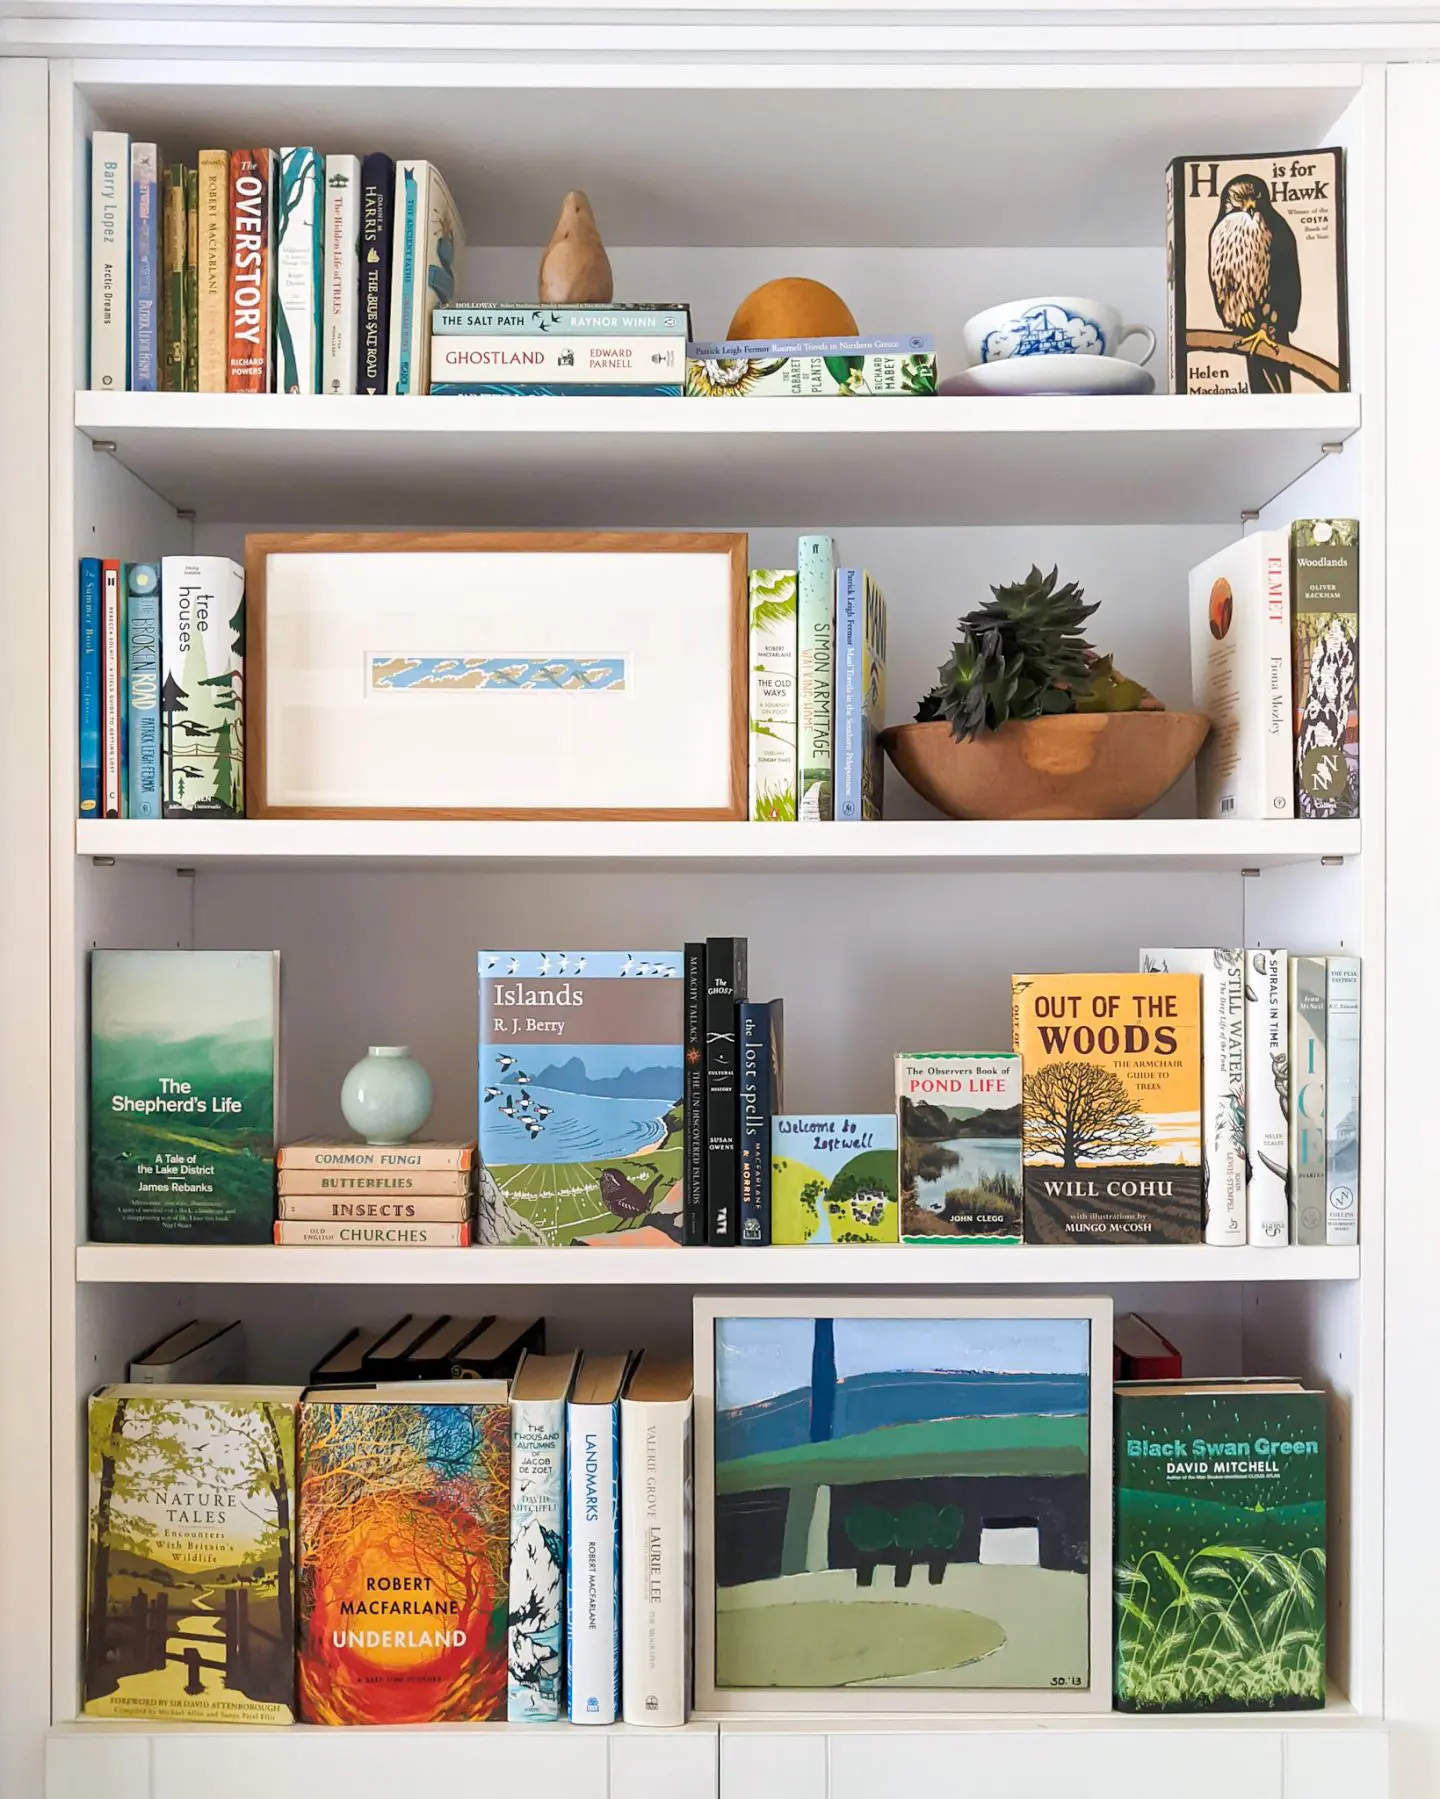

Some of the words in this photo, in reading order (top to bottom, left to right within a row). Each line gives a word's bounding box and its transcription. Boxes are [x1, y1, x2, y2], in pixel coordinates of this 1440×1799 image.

[240, 161, 258, 171] The
[1272, 162, 1286, 178] is
[1289, 160, 1316, 178] for
[102, 162, 117, 198] Barry
[1189, 163, 1219, 197] H
[208, 176, 217, 216] ROBERT
[334, 197, 342, 213] The
[364, 186, 377, 241] HARRIS
[102, 205, 117, 243] Lopez
[334, 217, 343, 249] Hidden
[208, 223, 217, 295] MACFARLANE
[234, 176, 262, 344] OVERSTORY
[333, 252, 342, 268] Life
[104, 264, 113, 289] Arctic
[333, 271, 342, 280] of
[368, 269, 378, 292] THE
[103, 293, 113, 324] Dreams
[333, 283, 341, 315] TREES
[367, 293, 378, 320] BLUE
[442, 316, 462, 325] THE
[467, 316, 493, 326] SALT
[497, 317, 524, 326] PATH
[570, 317, 617, 326] RAYNOR
[623, 317, 656, 326] WINN
[365, 322, 377, 346] SALT
[230, 358, 264, 366] RICHARD
[366, 348, 377, 378] ROAD
[445, 351, 545, 365] GHOSTLAND
[590, 349, 632, 358] EDWARD
[231, 367, 262, 375] POWERS
[589, 359, 632, 368] PARNELL
[1189, 365, 1229, 379] Helen
[791, 359, 801, 393] CABARET
[810, 358, 822, 392] PLANTS
[874, 357, 883, 390] RICHARD
[884, 357, 895, 390] MABEY
[1189, 382, 1249, 395] Macdonald
[1297, 557, 1348, 567] Woodlands
[1268, 557, 1283, 624] ELMET
[179, 586, 201, 652] houses
[197, 594, 214, 632] tree
[813, 623, 831, 673] SIMON
[1270, 657, 1282, 690] Fiona
[758, 680, 773, 688] THE
[774, 680, 792, 688] OLD
[763, 689, 786, 697] WAYS
[813, 680, 831, 759] ARMITAGE
[1268, 695, 1284, 736] Mozley
[690, 956, 698, 1001] MALACHY
[715, 978, 727, 986] The
[1269, 960, 1278, 1005] SPIRALS
[493, 983, 584, 1006] Islands
[708, 987, 734, 995] GHOST
[1227, 968, 1241, 1015] STILL
[1034, 996, 1081, 1018] OUT
[1092, 995, 1120, 1018] OF
[1132, 995, 1178, 1018] THE
[1269, 1008, 1278, 1018] IN
[493, 1019, 508, 1031] R.
[512, 1019, 521, 1035] J.
[526, 1019, 565, 1035] Berry
[689, 1004, 698, 1043] TALLACK
[745, 1019, 756, 1036] the
[1037, 1025, 1178, 1055] WOODS
[1269, 1024, 1278, 1048] TIME
[745, 1044, 763, 1077] lost
[1229, 1020, 1242, 1084] WATER
[906, 1067, 923, 1075] The
[976, 1067, 999, 1075] Book
[1001, 1067, 1011, 1075] of
[1133, 1060, 1183, 1068] ARMCHAIR
[159, 1078, 192, 1094] The
[910, 1079, 962, 1093] POND
[969, 1079, 1006, 1092] LIFE
[111, 1095, 207, 1115] Shepherd's
[212, 1097, 242, 1113] Life
[740, 1084, 764, 1135] spells
[155, 1154, 163, 1163] A
[165, 1154, 185, 1163] Tale
[186, 1154, 197, 1163] of
[315, 1154, 374, 1164] COMMON
[380, 1155, 421, 1165] FUNGI
[137, 1165, 153, 1174] the
[155, 1165, 178, 1174] Lake
[180, 1165, 215, 1174] District
[138, 1182, 169, 1192] James
[171, 1183, 213, 1192] Rebanks
[321, 1178, 413, 1188] BUTTERFLIES
[743, 1163, 751, 1202] MORRIS
[1044, 1181, 1099, 1197] WILL
[1106, 1181, 1173, 1197] COHU
[332, 1204, 416, 1217] INSECTS
[716, 1207, 727, 1234] TATE
[339, 1229, 428, 1242] CHURCHES
[514, 1432, 560, 1440] THOUSAND
[647, 1425, 657, 1473] VALERIE
[1127, 1439, 1187, 1457] Black
[1192, 1439, 1249, 1457] Swan
[1254, 1438, 1319, 1455] Green
[519, 1466, 529, 1474] DE
[531, 1466, 553, 1474] ZOET
[521, 1458, 551, 1466] JACOB
[1166, 1462, 1208, 1473] DAVID
[1213, 1461, 1279, 1472] MITCHELL
[585, 1434, 598, 1521] LANDMARKS
[156, 1492, 237, 1507] NATURE
[647, 1476, 657, 1518] GROVE
[166, 1509, 226, 1524] TALES
[164, 1529, 225, 1539] Encounters
[155, 1541, 182, 1550] With
[188, 1541, 234, 1551] Britain's
[650, 1527, 661, 1575] LAURIE
[171, 1553, 217, 1563] Wildlife
[589, 1541, 597, 1572] ROBERT
[366, 1577, 433, 1591] ROBERT
[650, 1579, 661, 1604] LEE
[339, 1601, 459, 1615] MACFARLANE
[589, 1574, 597, 1630] MACFARLANE
[332, 1630, 467, 1648] UNDERLAND
[110, 1697, 157, 1706] FOREWORD
[183, 1700, 209, 1709] DAVID
[210, 1702, 281, 1712] ATTENBOROUGH
